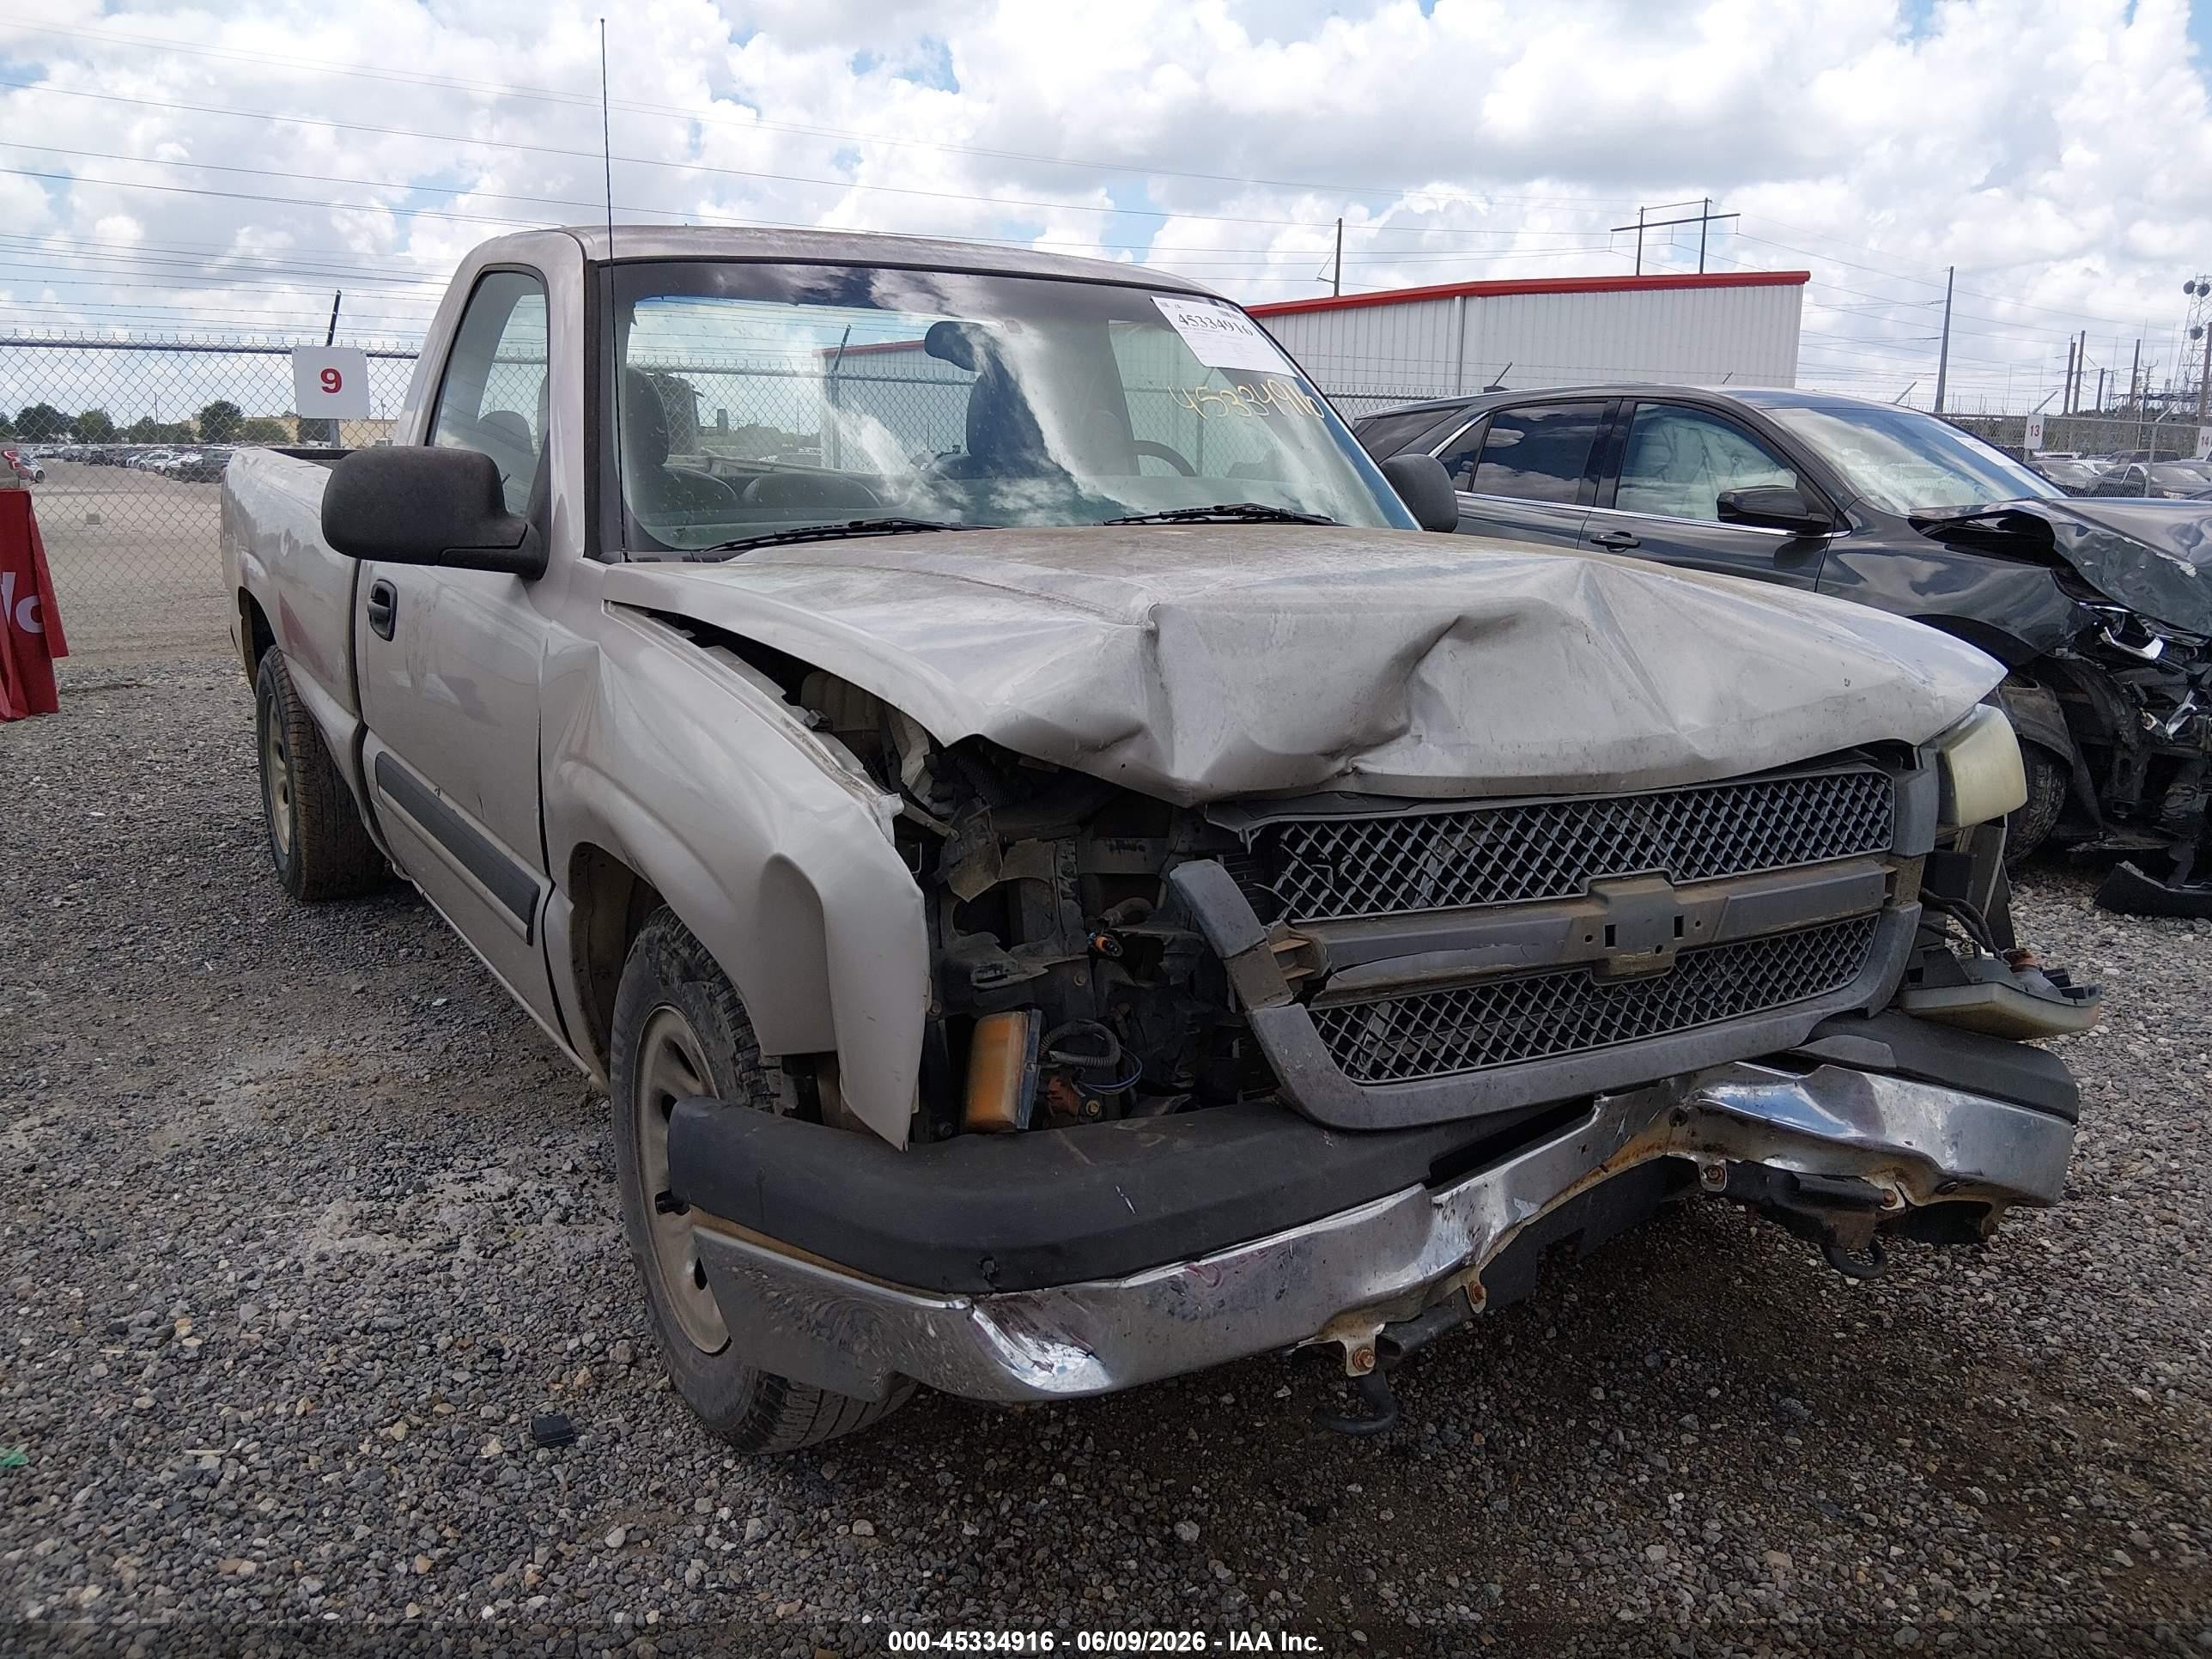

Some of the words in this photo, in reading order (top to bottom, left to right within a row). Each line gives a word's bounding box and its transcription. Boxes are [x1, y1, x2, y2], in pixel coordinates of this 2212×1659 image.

[1177, 313, 1254, 337] 45334916
[319, 368, 343, 394] 9
[1168, 379, 1325, 420] 45334916
[2030, 424, 2040, 437] 13
[2201, 435, 2209, 447] 14
